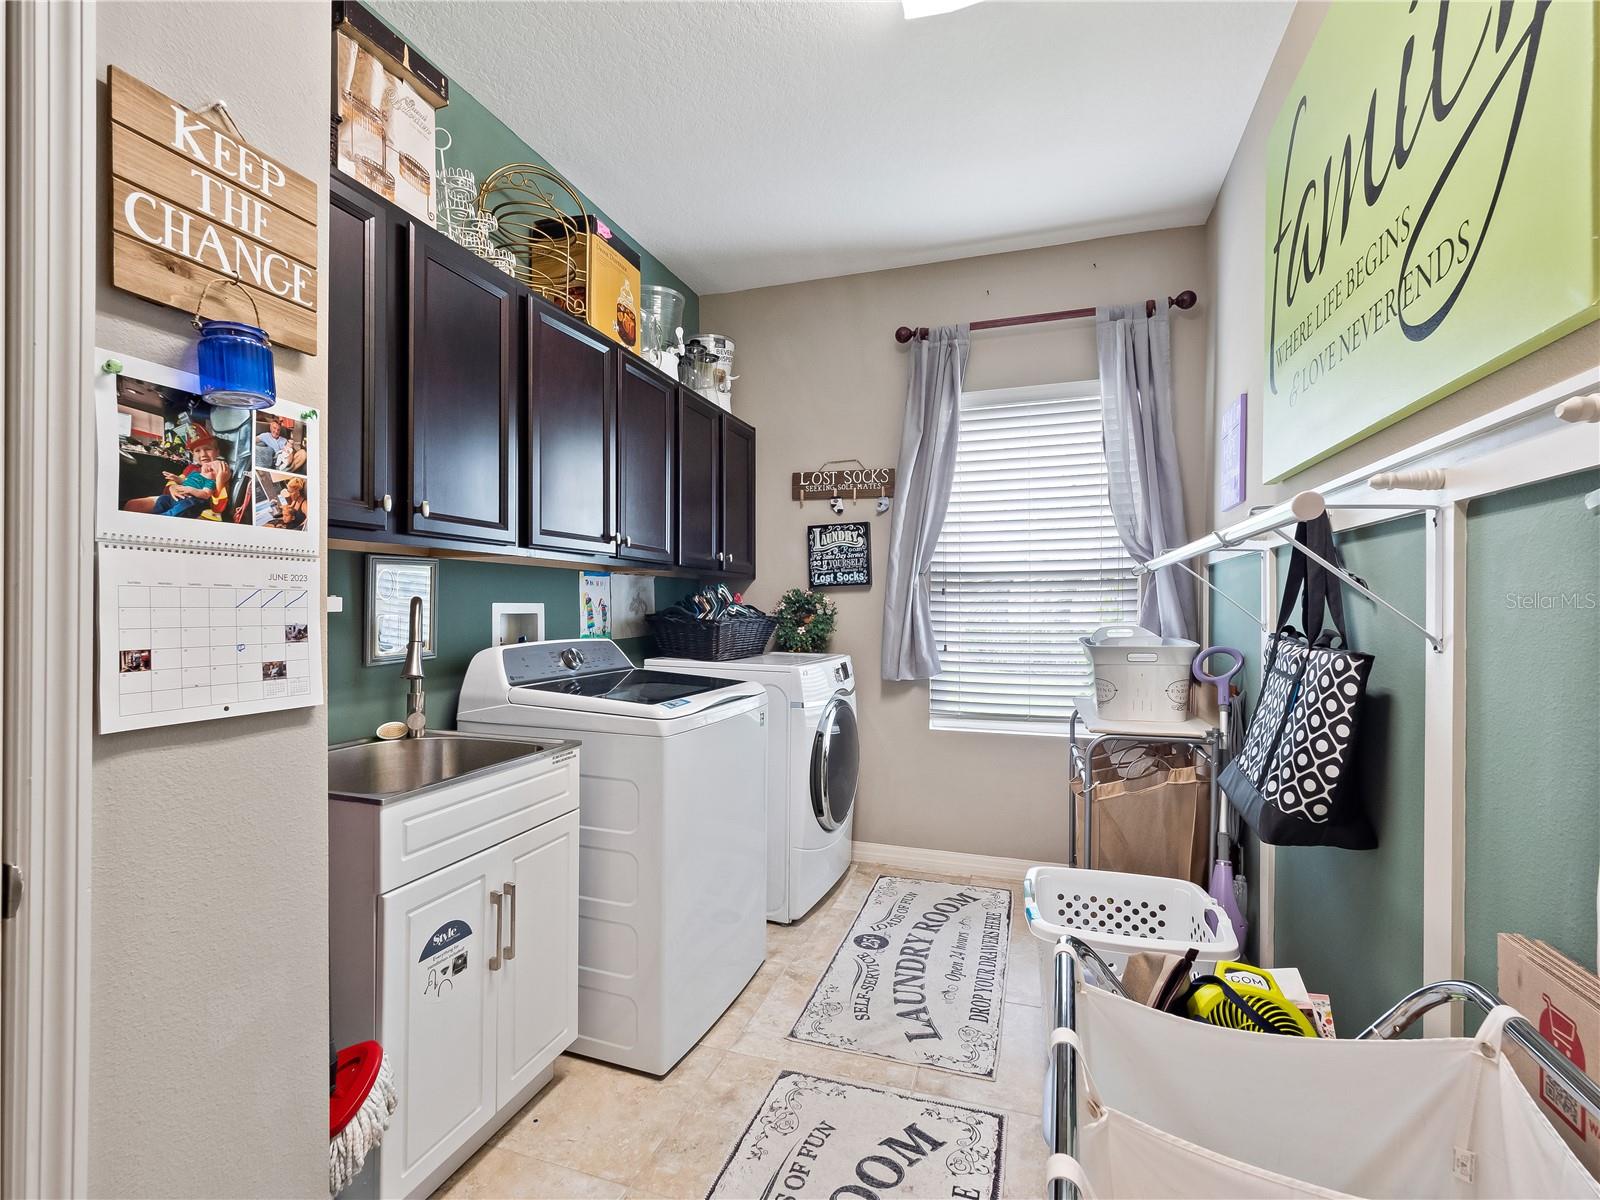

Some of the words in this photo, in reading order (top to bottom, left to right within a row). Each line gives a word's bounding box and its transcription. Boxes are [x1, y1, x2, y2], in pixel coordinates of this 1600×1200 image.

[171, 105, 285, 197] KEEP
[191, 169, 272, 243] THE
[125, 191, 313, 307] CHANGE
[1275, 312, 1313, 368] WHERE
[1315, 280, 1343, 330] LIFE
[1346, 205, 1410, 300] BEGINS
[1302, 341, 1336, 393] LOVE
[1339, 289, 1398, 362] NEVER
[1401, 219, 1470, 311] ENDS
[800, 471, 837, 485] LOST
[843, 468, 889, 485] SOCKS
[805, 484, 834, 493] SEEKING
[837, 483, 854, 491] SOLE
[857, 482, 882, 490] MATES
[267, 573, 289, 582] JUNE
[290, 574, 308, 582] 2023
[814, 573, 834, 583] Lost
[836, 571, 864, 582] Socks
[896, 904, 910, 914] OF
[900, 891, 919, 906] FUN
[870, 913, 906, 932] LOADS
[911, 892, 982, 934] ROOM
[984, 911, 1002, 931] HERE
[433, 927, 457, 946] Style
[951, 931, 969, 951] hours
[978, 930, 1000, 968] DRAWERS
[949, 950, 966, 961] 24
[944, 961, 967, 982] Open
[973, 968, 996, 993] YOUR
[854, 952, 880, 1021] SELF-SERVICE
[892, 932, 943, 1043] LAUNDRY
[968, 993, 992, 1024] DROP
[796, 1120, 837, 1161] FUN
[784, 1161, 811, 1191] OF
